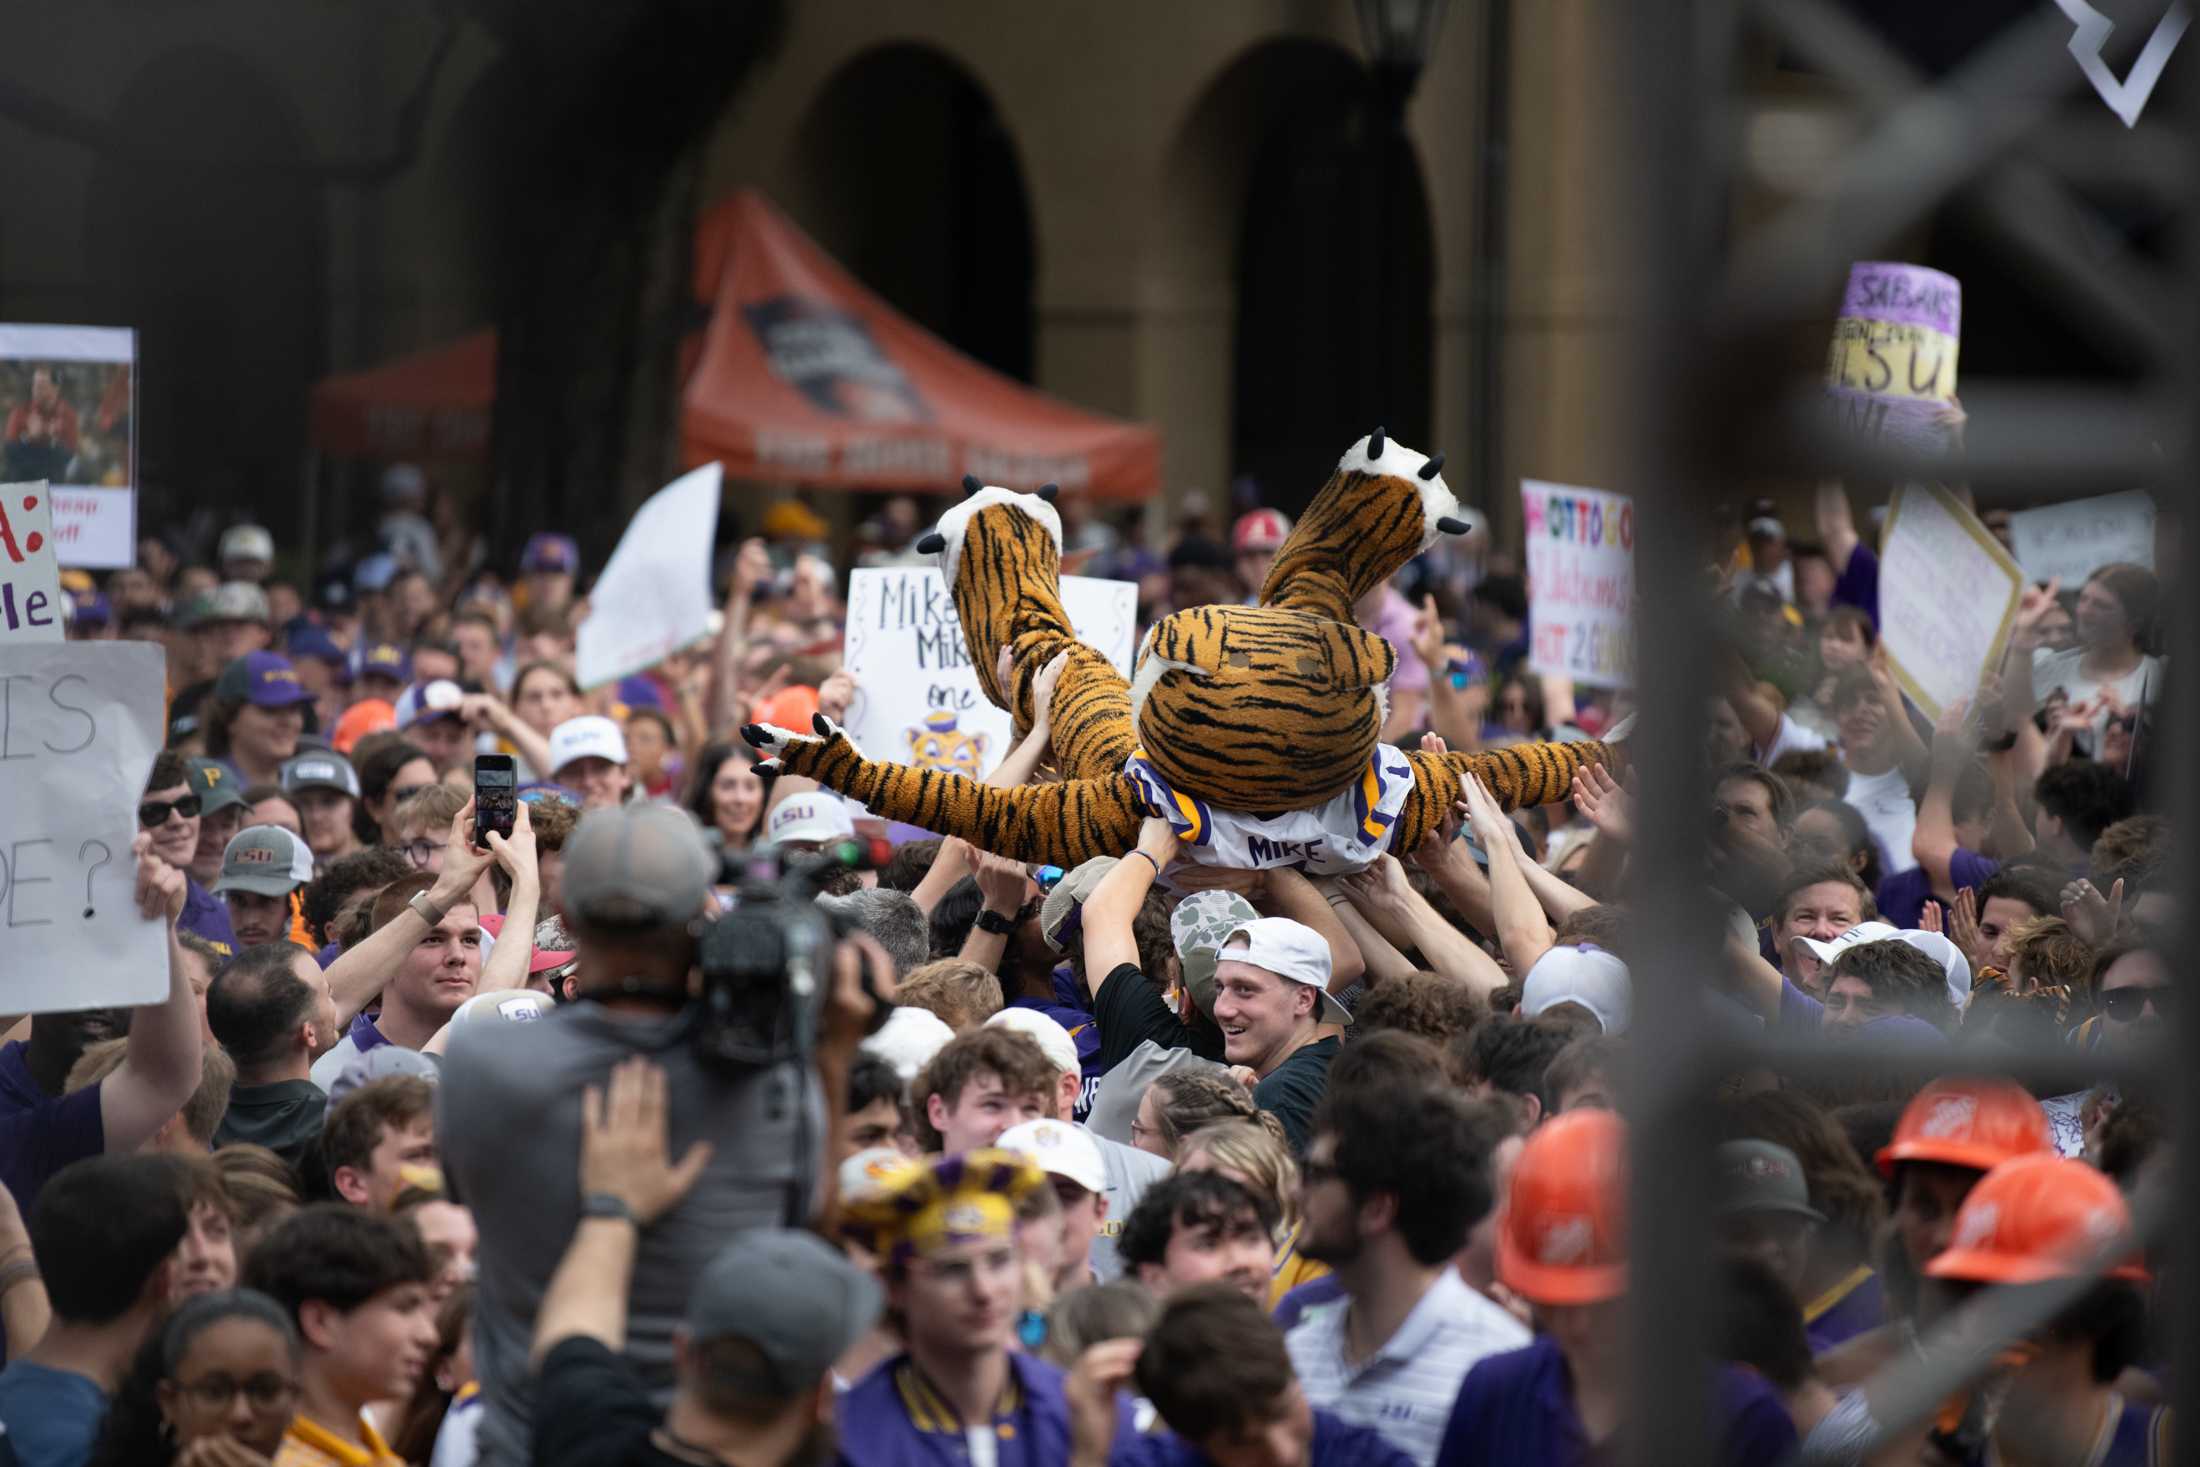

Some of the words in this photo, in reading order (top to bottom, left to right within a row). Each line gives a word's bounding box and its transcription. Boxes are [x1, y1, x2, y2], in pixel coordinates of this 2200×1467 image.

[928, 684, 976, 710] one
[203, 768, 221, 788] P
[773, 805, 815, 831] LSU
[233, 848, 274, 865] LSU
[1247, 836, 1326, 867] MIKE
